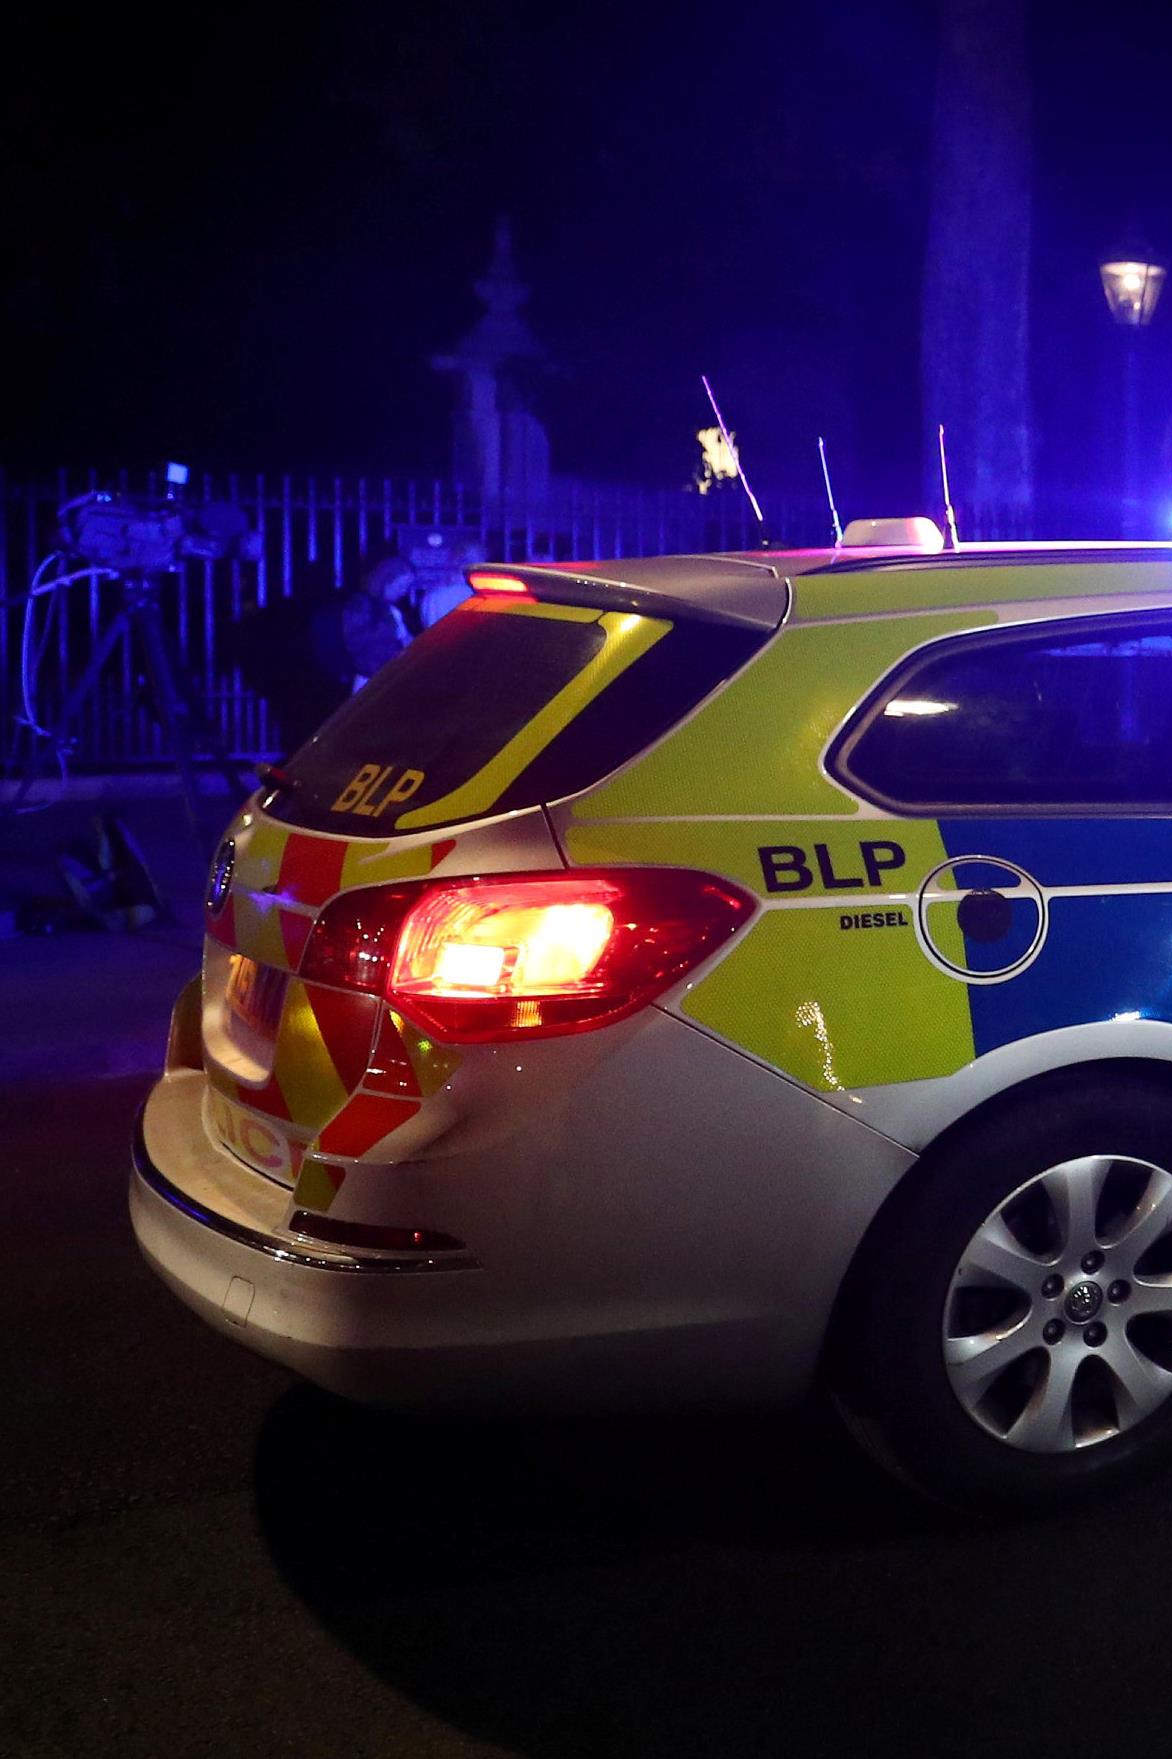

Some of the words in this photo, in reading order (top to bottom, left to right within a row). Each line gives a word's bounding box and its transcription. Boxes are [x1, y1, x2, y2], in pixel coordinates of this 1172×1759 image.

[330, 763, 425, 817] BLP
[757, 840, 906, 893] BLP
[839, 911, 908, 930] DIESEL
